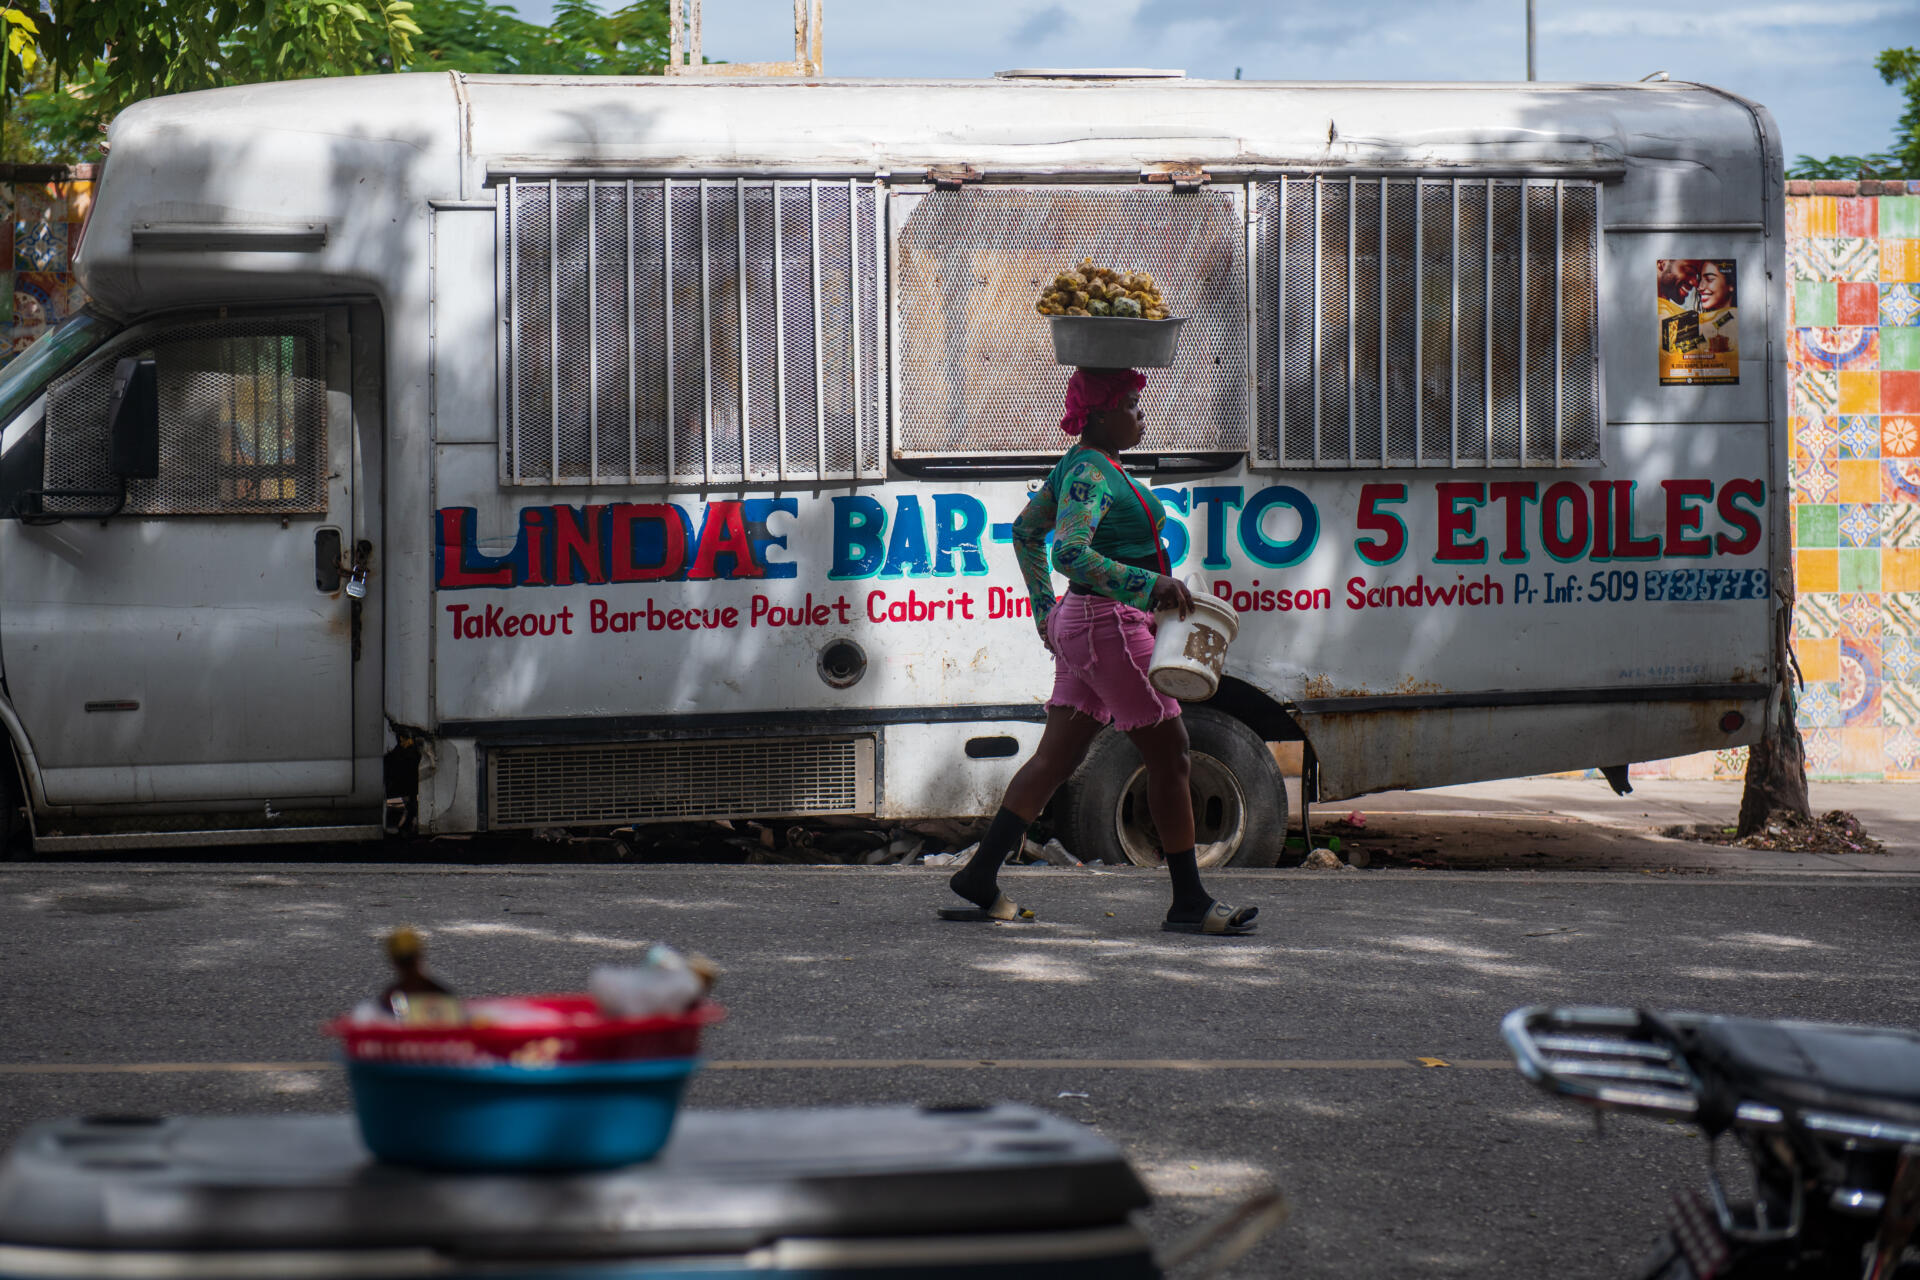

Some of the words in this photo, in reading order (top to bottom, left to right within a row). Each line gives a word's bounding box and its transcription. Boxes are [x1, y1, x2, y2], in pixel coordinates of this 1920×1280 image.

[1354, 483, 1409, 567] 5
[1431, 479, 1766, 565] ETOILES
[589, 599, 738, 634] Barbecue
[751, 592, 850, 628] Poulet
[867, 588, 974, 624] Cabrit
[1346, 574, 1503, 610] Sandwich
[1587, 570, 1639, 602] 509
